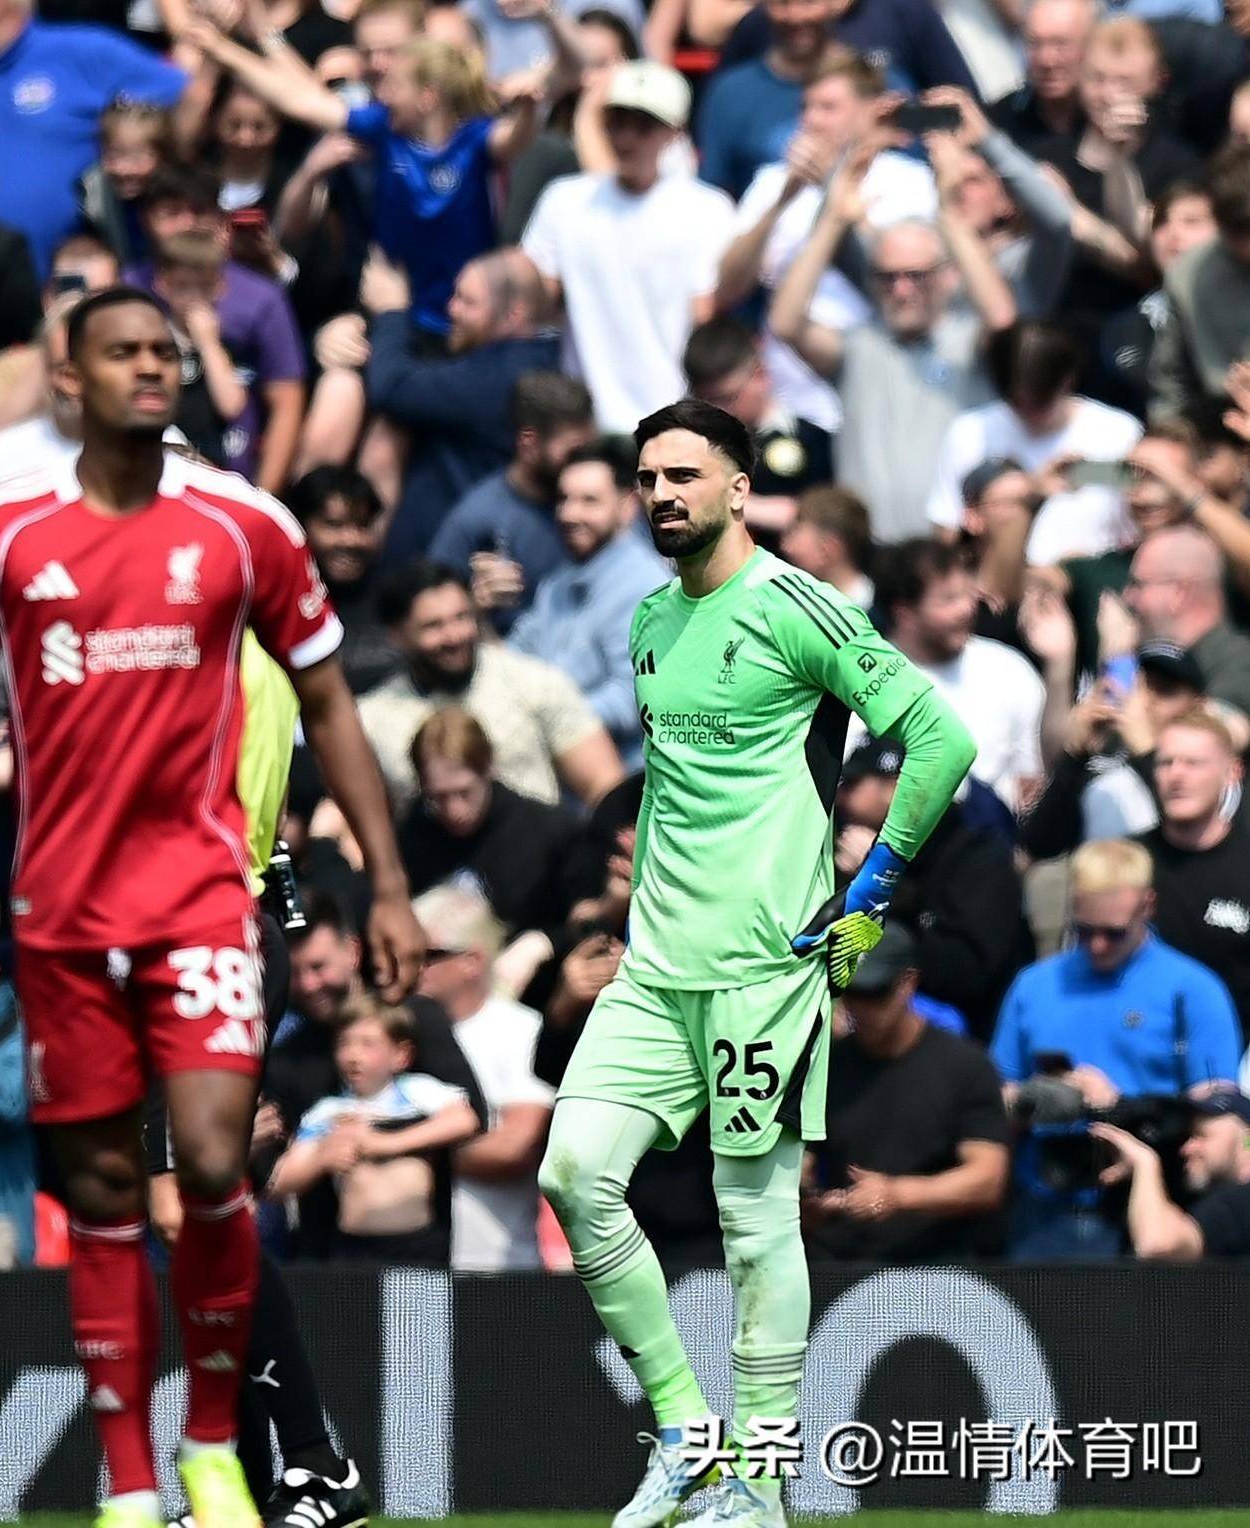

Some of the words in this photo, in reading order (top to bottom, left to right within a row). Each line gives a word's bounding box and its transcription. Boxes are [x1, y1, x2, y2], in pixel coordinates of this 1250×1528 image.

[717, 674, 737, 685] LFC
[659, 710, 727, 729] standard
[658, 728, 736, 745] chartered
[167, 945, 261, 1021] 38
[712, 1038, 780, 1101] 25
